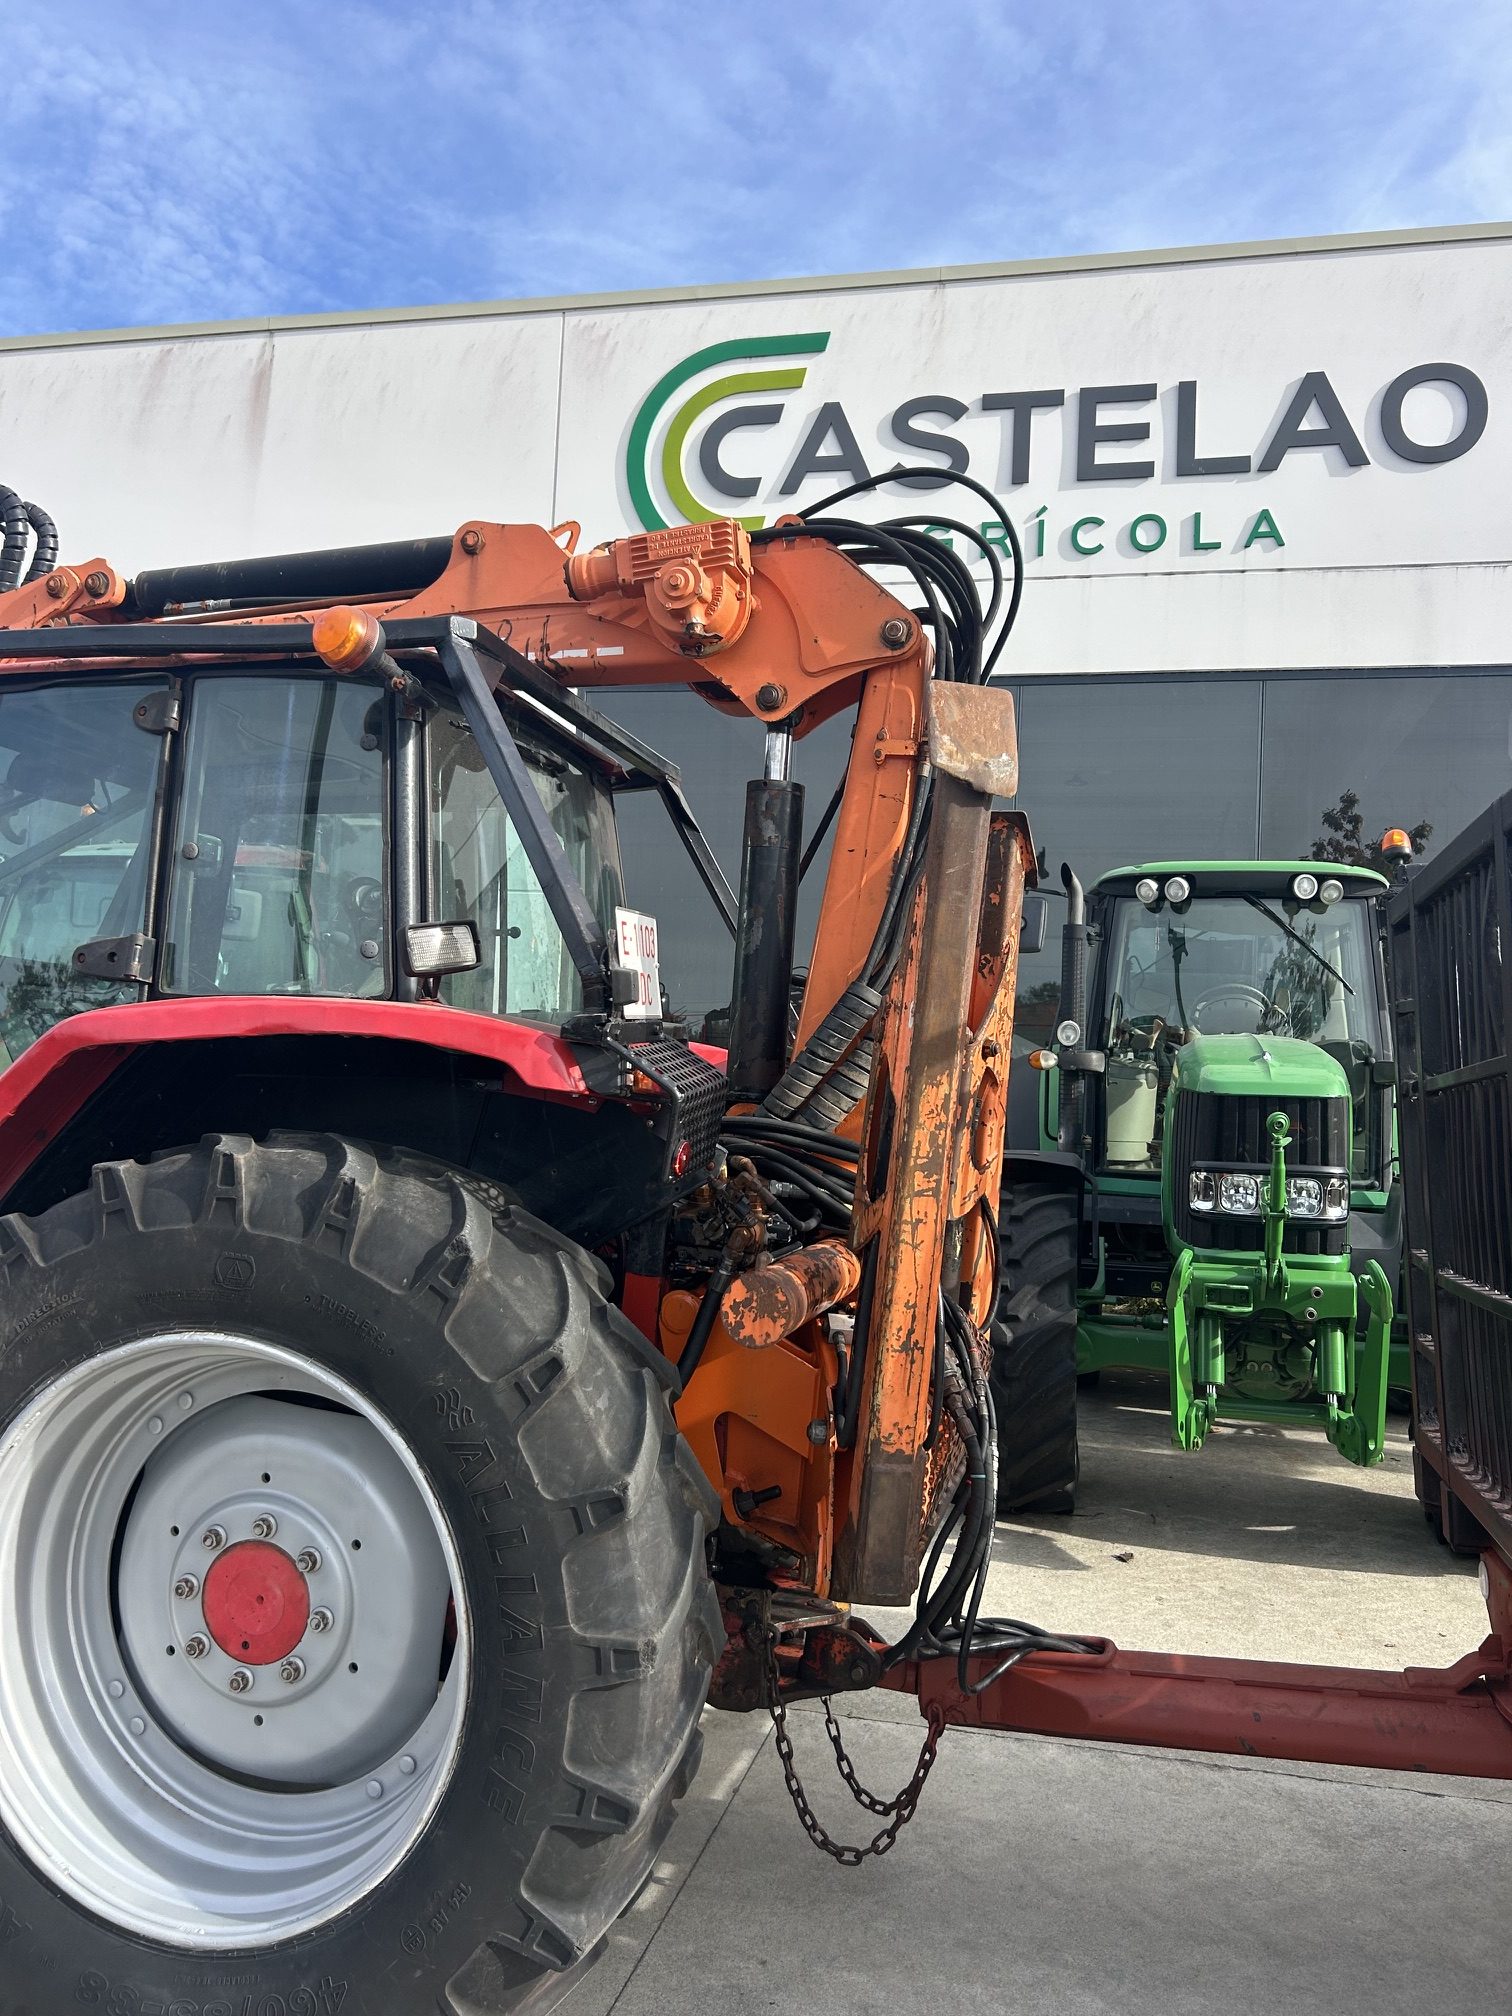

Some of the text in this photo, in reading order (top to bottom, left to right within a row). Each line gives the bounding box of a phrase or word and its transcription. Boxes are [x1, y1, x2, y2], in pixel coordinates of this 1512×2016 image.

[699, 362, 1489, 498] CASTELAO
[321, 1294, 387, 1342] TUBELESS
[443, 1439, 545, 1826] ALLIANCE
